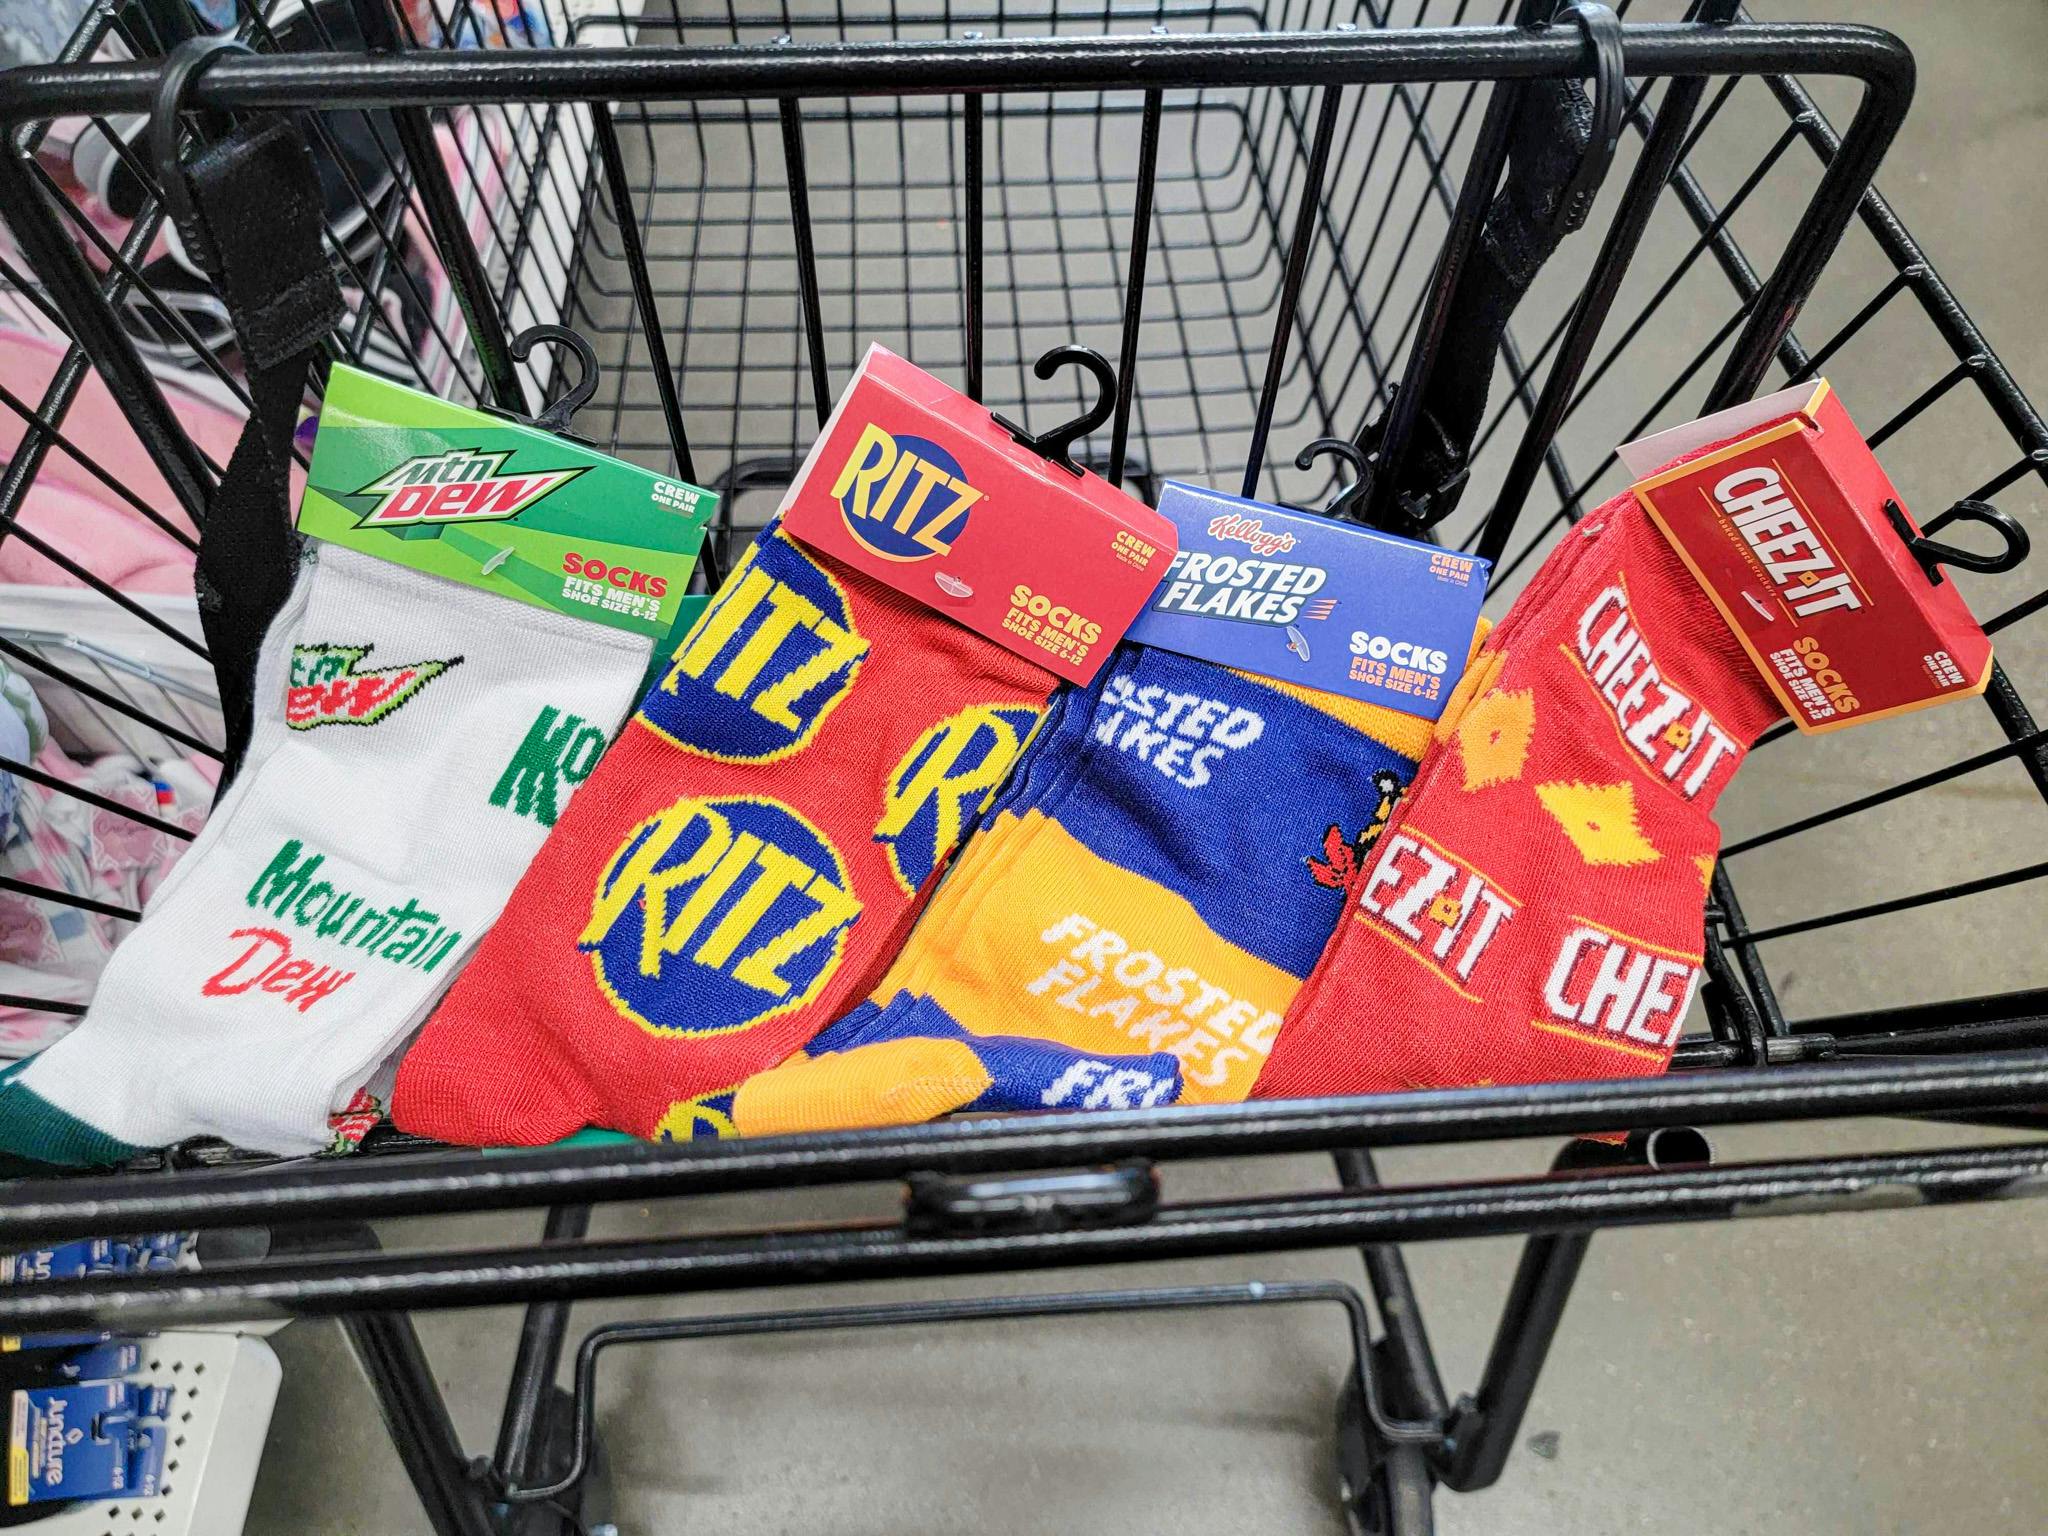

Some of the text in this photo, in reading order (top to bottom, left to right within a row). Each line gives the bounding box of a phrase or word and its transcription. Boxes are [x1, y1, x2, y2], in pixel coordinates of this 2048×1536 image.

[651, 493, 673, 506] ONE
[672, 499, 695, 514] PAIR
[653, 481, 700, 505] CREW
[830, 422, 984, 557] RITZ
[1111, 541, 1149, 567] ONE PAIR
[1116, 530, 1157, 559] CREW
[1208, 513, 1297, 556] Kellogg's
[562, 552, 668, 598] SOCKS
[1163, 550, 1327, 596] FROSTED
[1429, 565, 1470, 582] ONE PAIR
[1431, 553, 1474, 573] CREW
[1718, 518, 1777, 597] baked snack crackers
[561, 588, 658, 622] SHOE SIZE 6-12
[564, 576, 661, 612] FITS MEN'S
[1010, 584, 1102, 645] SOCKS
[1158, 580, 1306, 624] FLAKES
[661, 543, 871, 732] ITZ
[1001, 618, 1083, 666] SHOE SIZE 6-12
[1006, 607, 1089, 657] FITS MEN'S
[1349, 630, 1448, 675] SOCKS
[1349, 669, 1439, 701] SHOE SIZE 6-12
[1351, 656, 1440, 690] FITS MEN'S
[1769, 652, 1823, 720] SHOE SIZE 6-12
[1780, 648, 1836, 717] FITS MEN'S
[1793, 636, 1860, 713] SOCKS
[1923, 655, 1940, 671] ONE
[1933, 669, 1950, 687] PAIR
[1933, 651, 1966, 684] CREW
[246, 839, 462, 975] Mountain
[578, 798, 865, 998] RITZ
[1543, 927, 1701, 1047] CHE
[1025, 958, 1249, 1088] FLAKES
